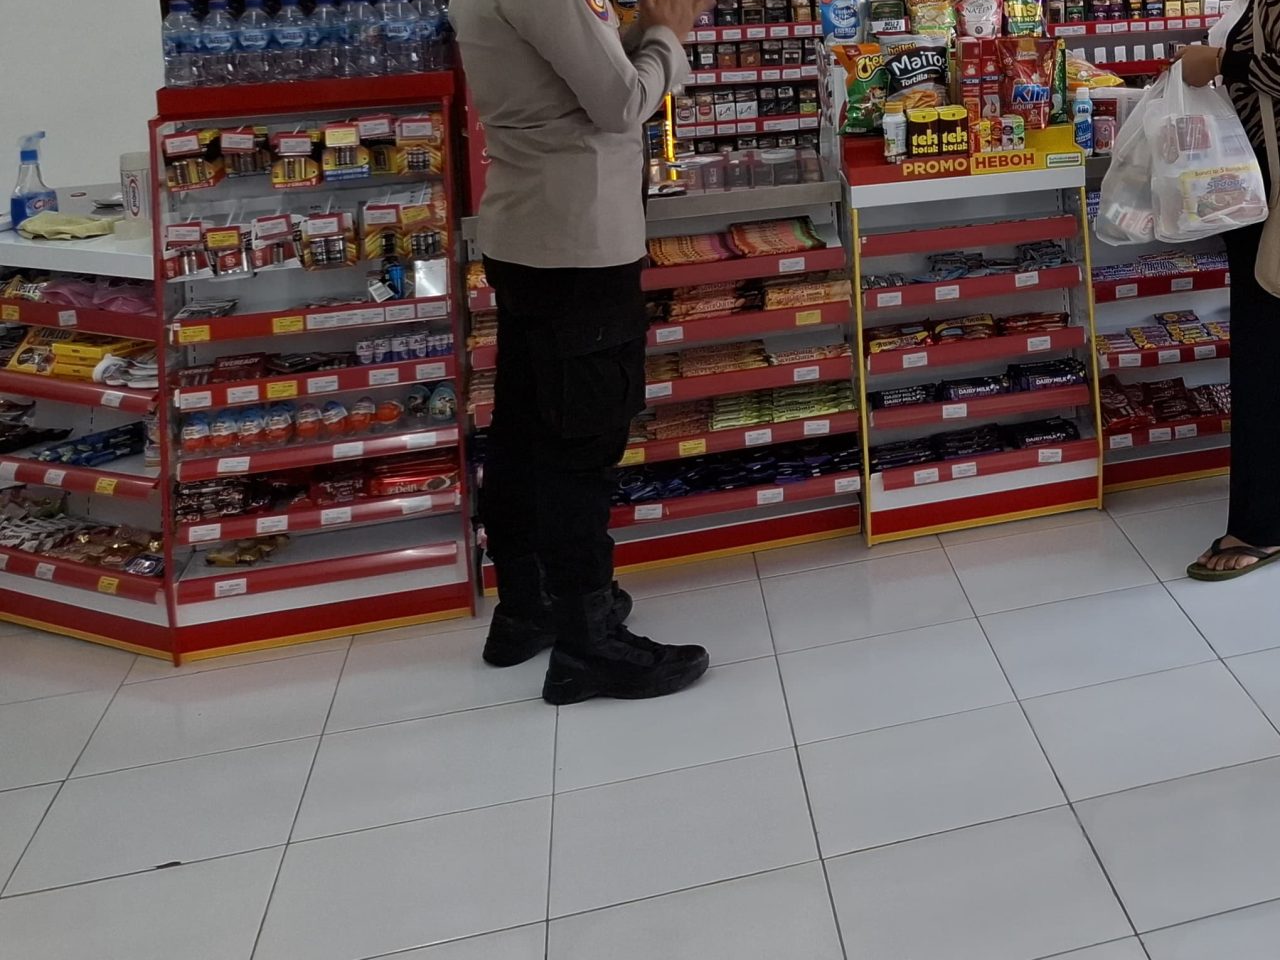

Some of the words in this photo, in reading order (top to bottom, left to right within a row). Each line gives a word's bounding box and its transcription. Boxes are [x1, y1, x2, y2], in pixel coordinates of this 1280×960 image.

[901, 73, 928, 87] Tortilla
[911, 129, 939, 146] teh
[941, 127, 968, 144] teh
[912, 145, 939, 155] kotak
[942, 142, 968, 152] kotak
[903, 158, 968, 176] PROMO
[975, 153, 1034, 169] HEBOH
